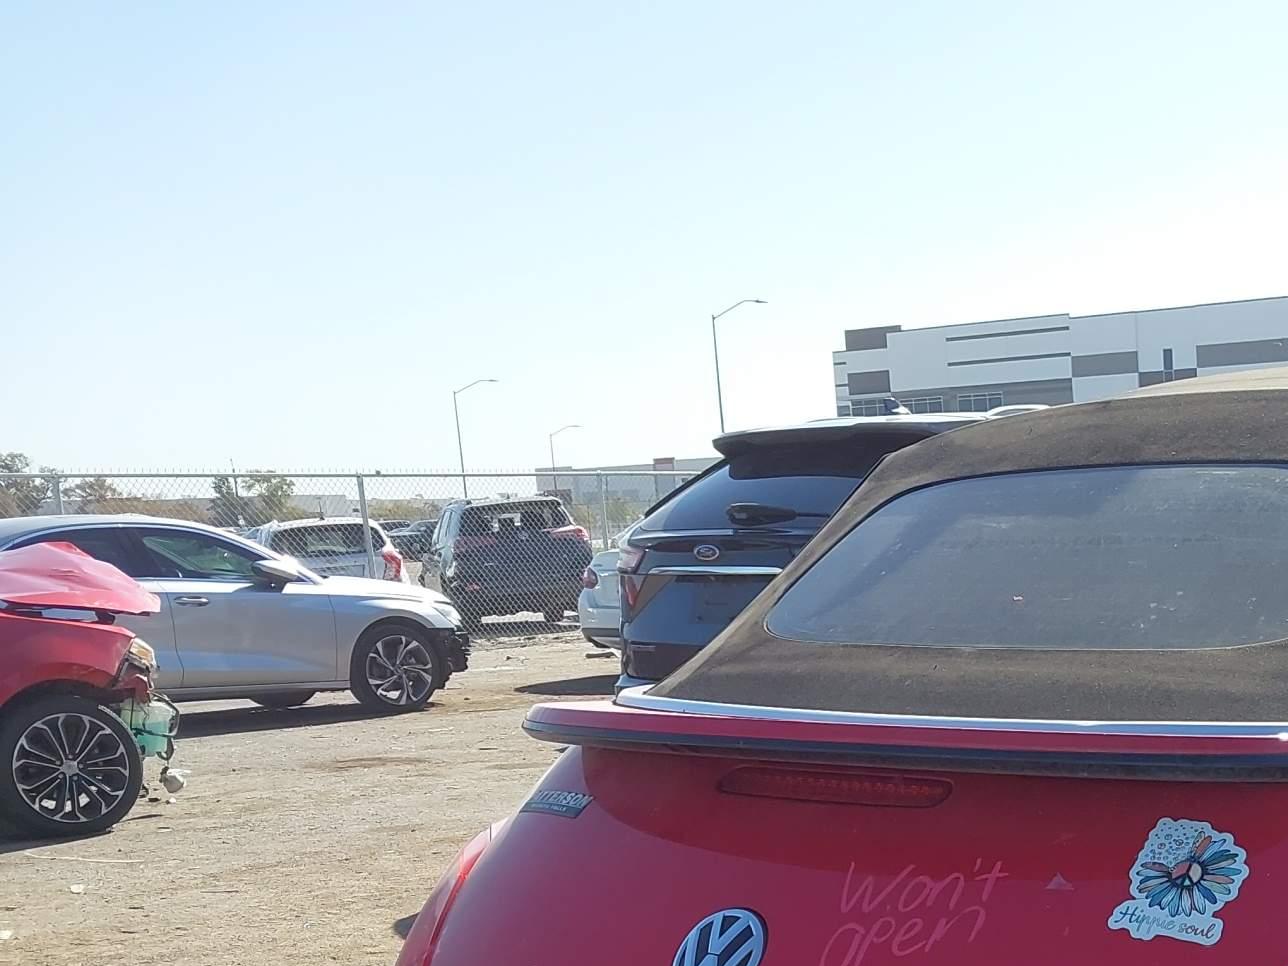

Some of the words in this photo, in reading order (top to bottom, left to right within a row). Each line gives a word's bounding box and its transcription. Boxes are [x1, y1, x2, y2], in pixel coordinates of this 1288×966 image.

[839, 857, 1009, 913] Won't
[1114, 906, 1177, 934] Hippie
[1178, 922, 1217, 940] soul
